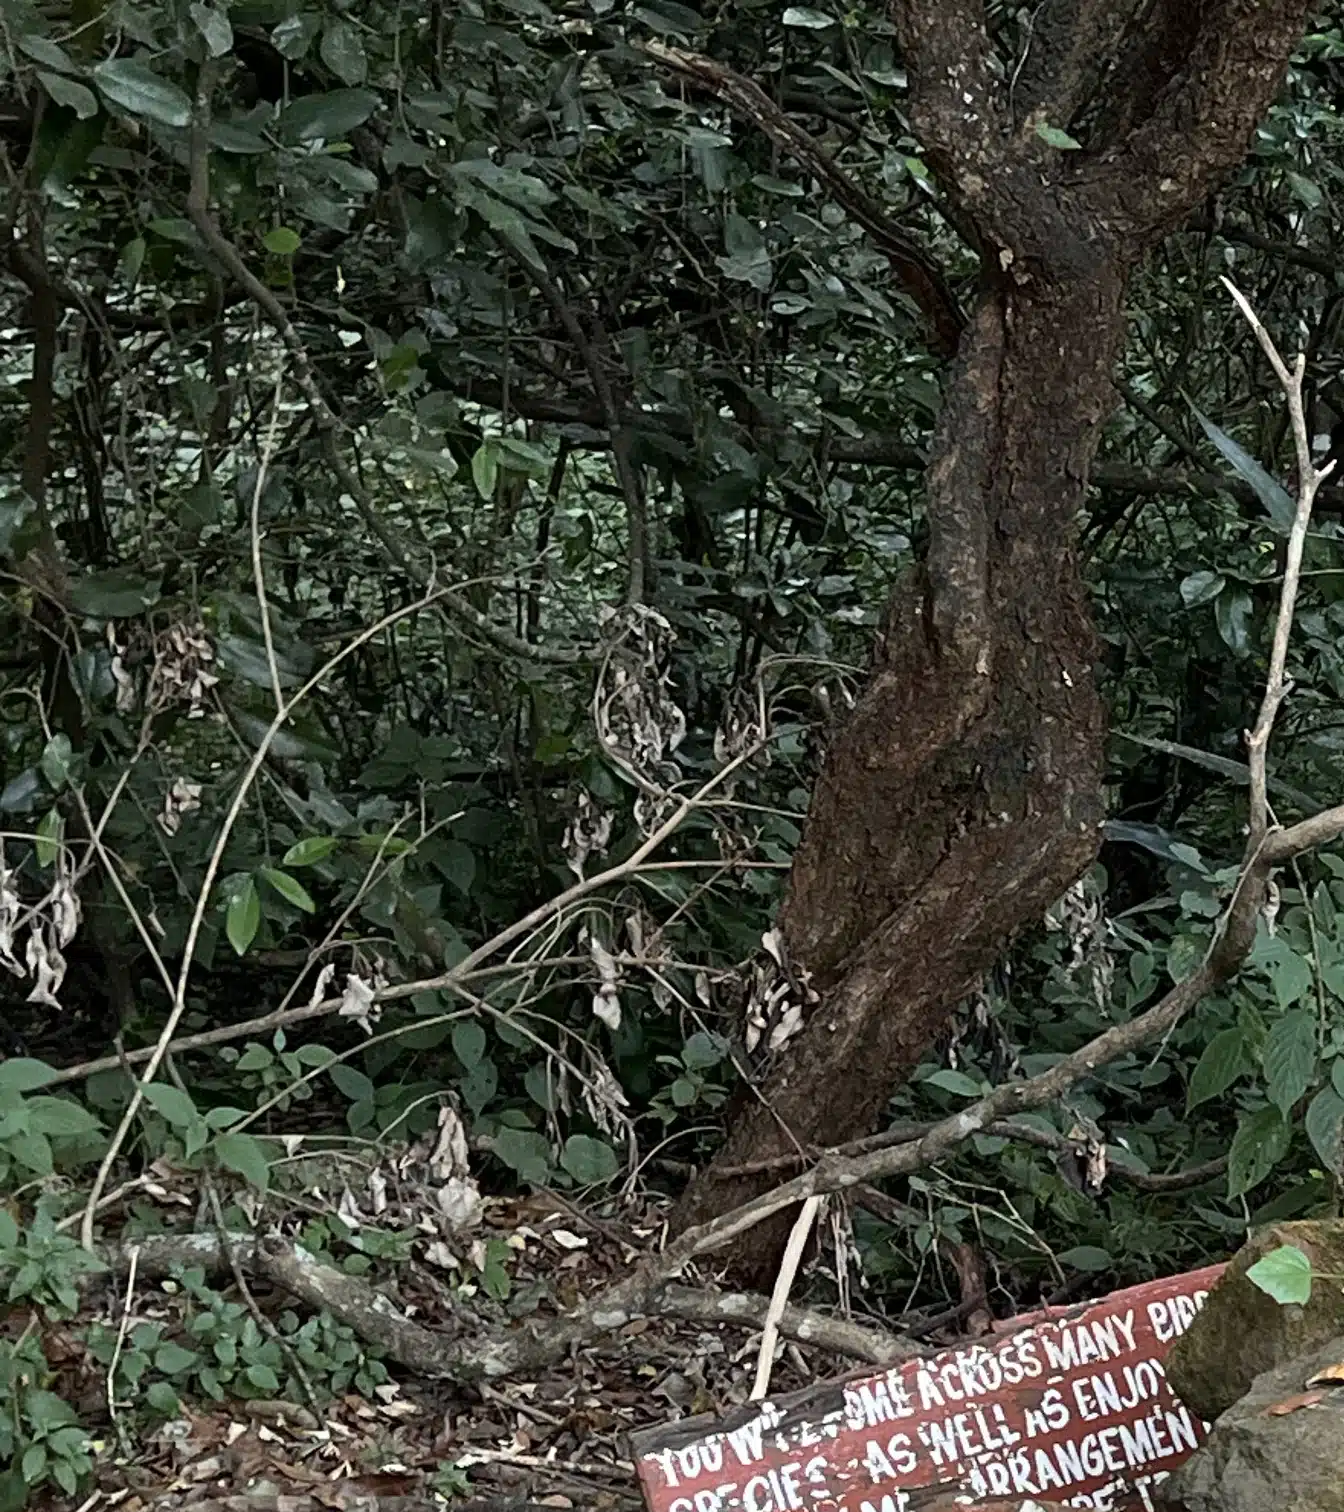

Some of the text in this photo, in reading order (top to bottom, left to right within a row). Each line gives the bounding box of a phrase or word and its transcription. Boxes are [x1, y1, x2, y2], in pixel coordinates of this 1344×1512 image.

[916, 1328, 1042, 1412] ACROSS
[1042, 1309, 1137, 1372] MANY
[863, 1433, 917, 1484] AS
[919, 1404, 1022, 1466] WELL
[1024, 1388, 1070, 1438] AS
